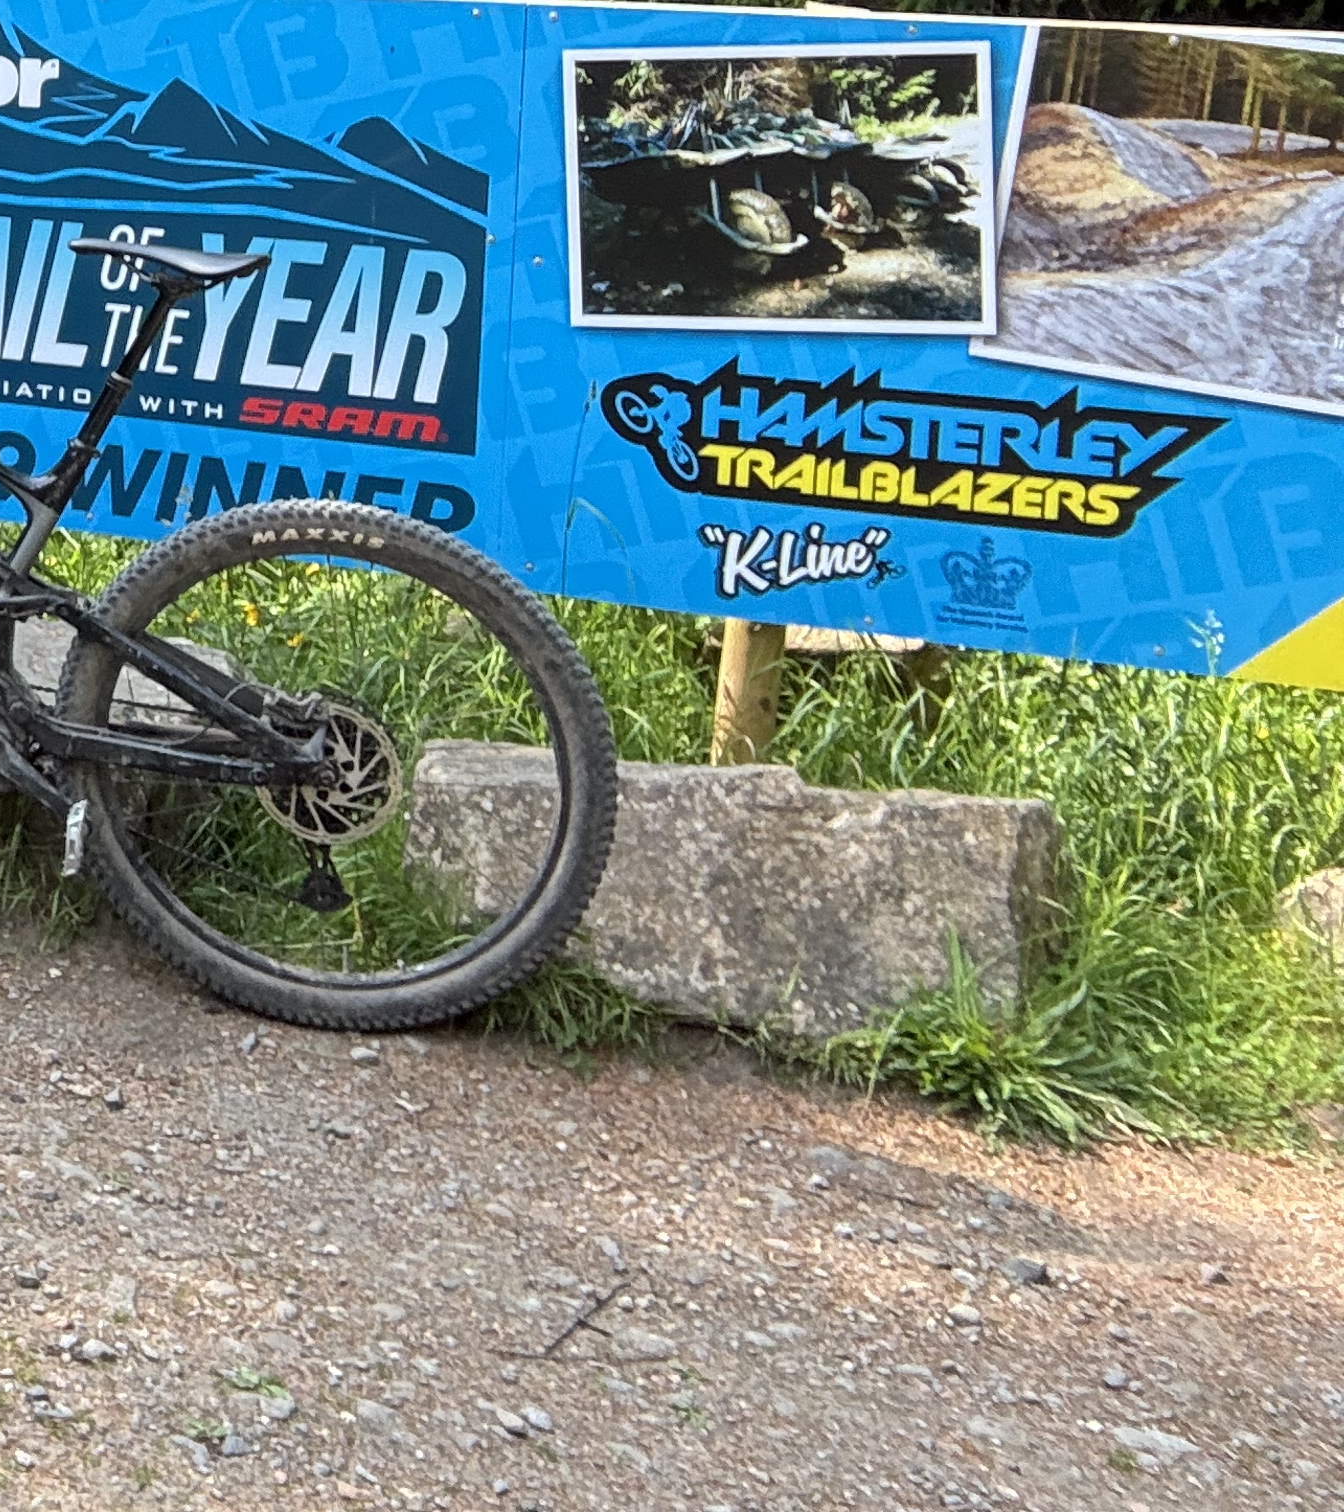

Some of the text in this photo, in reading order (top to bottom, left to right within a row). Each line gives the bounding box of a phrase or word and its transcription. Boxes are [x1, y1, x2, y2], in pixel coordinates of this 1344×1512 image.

[100, 224, 166, 292] OF
[100, 303, 190, 376] THE
[193, 232, 467, 405] YEAR
[138, 394, 224, 420] WITH
[238, 396, 442, 442] SRAM
[701, 386, 1188, 479] HAMSTERLEY
[698, 443, 1142, 527] TRAILBLAZERS
[251, 528, 385, 550] MAXXIS
